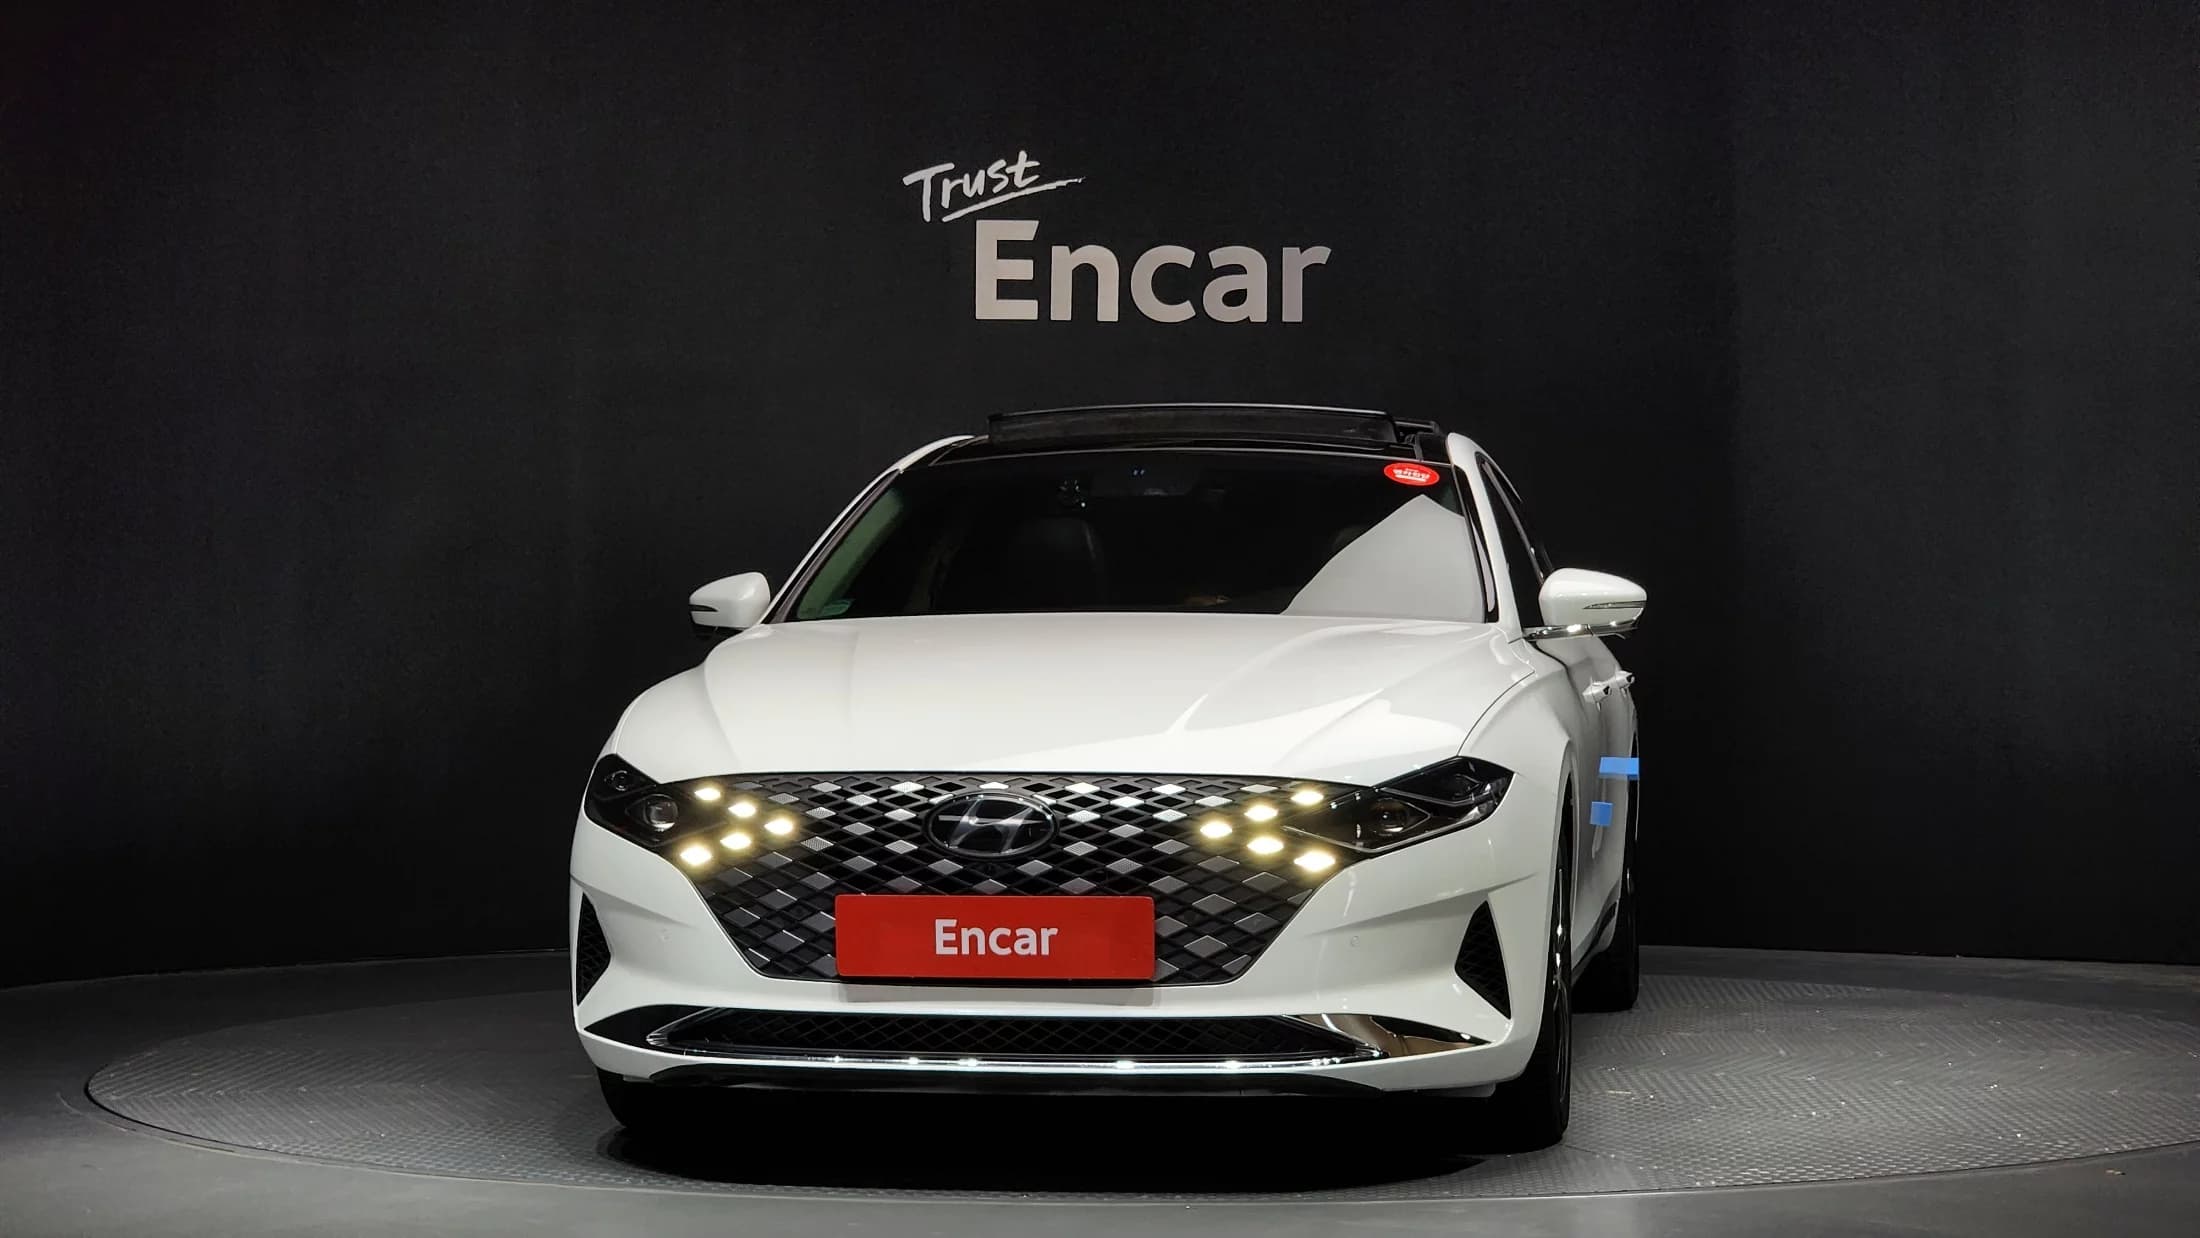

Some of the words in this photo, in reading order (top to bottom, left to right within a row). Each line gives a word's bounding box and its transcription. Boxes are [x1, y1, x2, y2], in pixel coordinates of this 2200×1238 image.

[903, 150, 1042, 222] Trust
[974, 219, 1331, 323] Encar
[934, 918, 1058, 956] Encar
